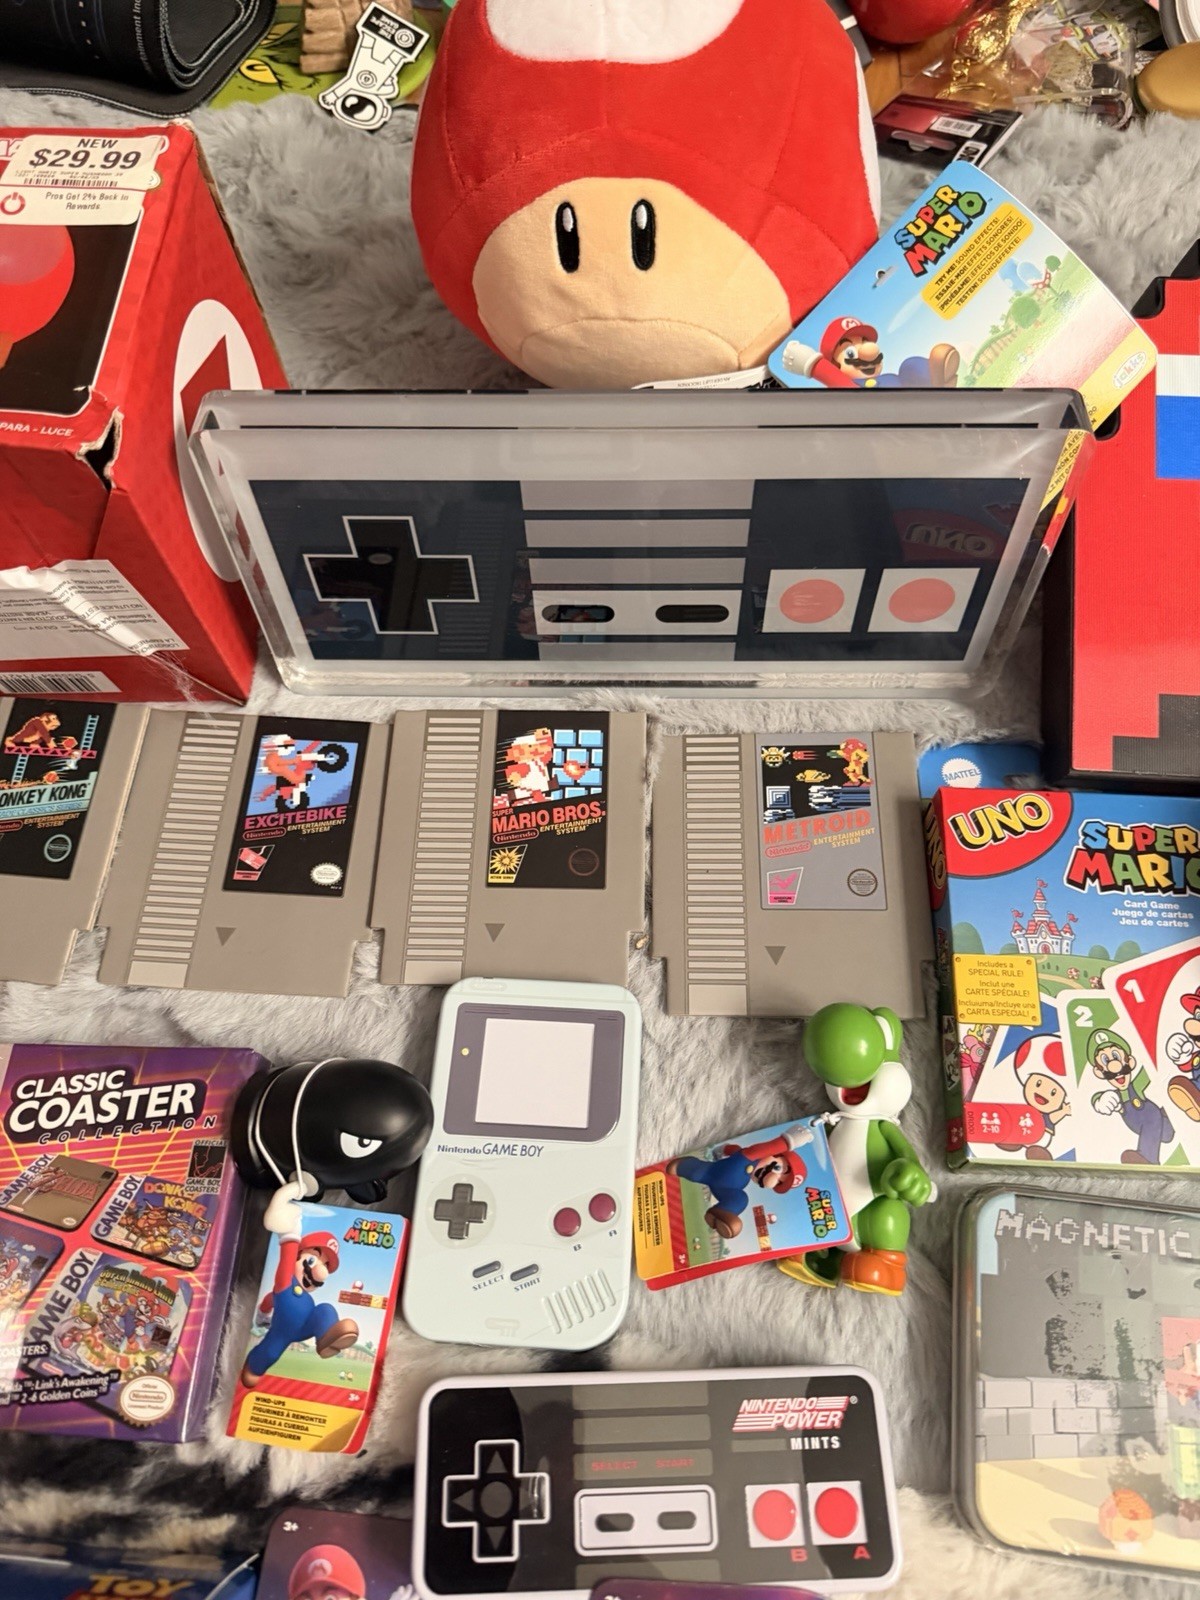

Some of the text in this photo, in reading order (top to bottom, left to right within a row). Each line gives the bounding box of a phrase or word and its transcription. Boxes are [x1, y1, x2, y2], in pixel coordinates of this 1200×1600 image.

[77, 138, 118, 149] NEW
[29, 147, 142, 170] $29.99
[45, 191, 64, 200] Pros
[66, 192, 80, 201] Get
[65, 202, 100, 210] Rewards
[894, 184, 958, 250] SUPER
[904, 191, 987, 277] MARIO
[993, 242, 1004, 253] DE
[1001, 218, 1025, 246] SONIDO!
[966, 244, 988, 269] EFFETS
[985, 216, 1014, 248] SONORES!
[934, 272, 949, 287] TRY
[955, 242, 976, 266] SOUND
[974, 217, 1000, 246] EFFECTS!
[956, 236, 1022, 307] TESTEN! SOUNDEFFEKTE!
[0, 422, 74, 437] PARA LUCE
[944, 768, 980, 782] MATTEL
[48, 783, 88, 802] KONG
[23, 813, 81, 825] ENTERTAINMENT
[244, 805, 348, 830] EXCITEBIKE
[492, 807, 514, 817] SUPER
[492, 800, 606, 834] MARIO BROS.
[37, 820, 66, 829] SYSTEM
[287, 818, 347, 832] ENTERTAINMENT
[540, 817, 603, 833] ENTERTAINMENT
[763, 808, 872, 845] METROID
[950, 794, 1051, 850] UNO
[246, 826, 331, 839] Nintendo SYSTEM
[496, 825, 587, 842] Nintendo SYSTEM
[813, 827, 876, 846] ENTERTAINMENT
[1081, 820, 1200, 855] SUPER
[769, 837, 861, 856] Nintendo SYSTEM
[1123, 900, 1180, 910] Card Game
[1112, 908, 1194, 920] Juego de cartas
[1119, 918, 1189, 928] Jeu de cartes
[977, 960, 1007, 968] Includes
[968, 968, 1024, 977] SPECIAL RULE!
[965, 987, 1030, 997] CARTE SPÉCIALE!
[979, 980, 1000, 988] Inclut
[1123, 978, 1146, 1004] 1
[966, 1008, 1029, 1017] CARTA ESPECIAL!
[1073, 1005, 1094, 1028] 2
[16, 1069, 126, 1100] CLASSIC
[9, 1082, 196, 1133] COASTER
[38, 1115, 217, 1146] COLLECTION
[982, 1124, 1000, 1134] 2-10
[1022, 1127, 1032, 1136] 7+
[437, 1143, 544, 1158] Nintendo GAME BOY
[0, 1153, 54, 1207] GAME BOY
[186, 1178, 206, 1186] GAME
[184, 1185, 219, 1193] COASTERS
[94, 1174, 144, 1239] GAME BOY
[805, 1186, 829, 1239] MARIO
[819, 1190, 838, 1231] SUPER
[352, 1217, 393, 1235] SUPER
[996, 1208, 1193, 1259] MAGNETIC
[343, 1226, 396, 1249] MARIO
[573, 1243, 582, 1252] B
[60, 1250, 95, 1295] BOY
[472, 1274, 541, 1293] SELECT START
[39, 1389, 71, 1402] Golden
[72, 1387, 99, 1400] Coins
[132, 1392, 164, 1400] Nintendo
[255, 1396, 286, 1407] WIND-UPS
[348, 1394, 361, 1402] 3+
[739, 1397, 818, 1413] NINTENDO
[252, 1406, 285, 1417] FIGURINES
[291, 1413, 328, 1425] REMONTER
[771, 1411, 844, 1430] POWER
[250, 1416, 277, 1426] FIGURAS
[284, 1422, 310, 1432] CUERDA
[248, 1425, 302, 1441] AUFZIEHFIGUREN
[790, 1436, 841, 1450] MINTS
[282, 1521, 299, 1532] 3+
[790, 1548, 808, 1562] B
[853, 1546, 871, 1560] A
[89, 1573, 195, 1598] TOY
